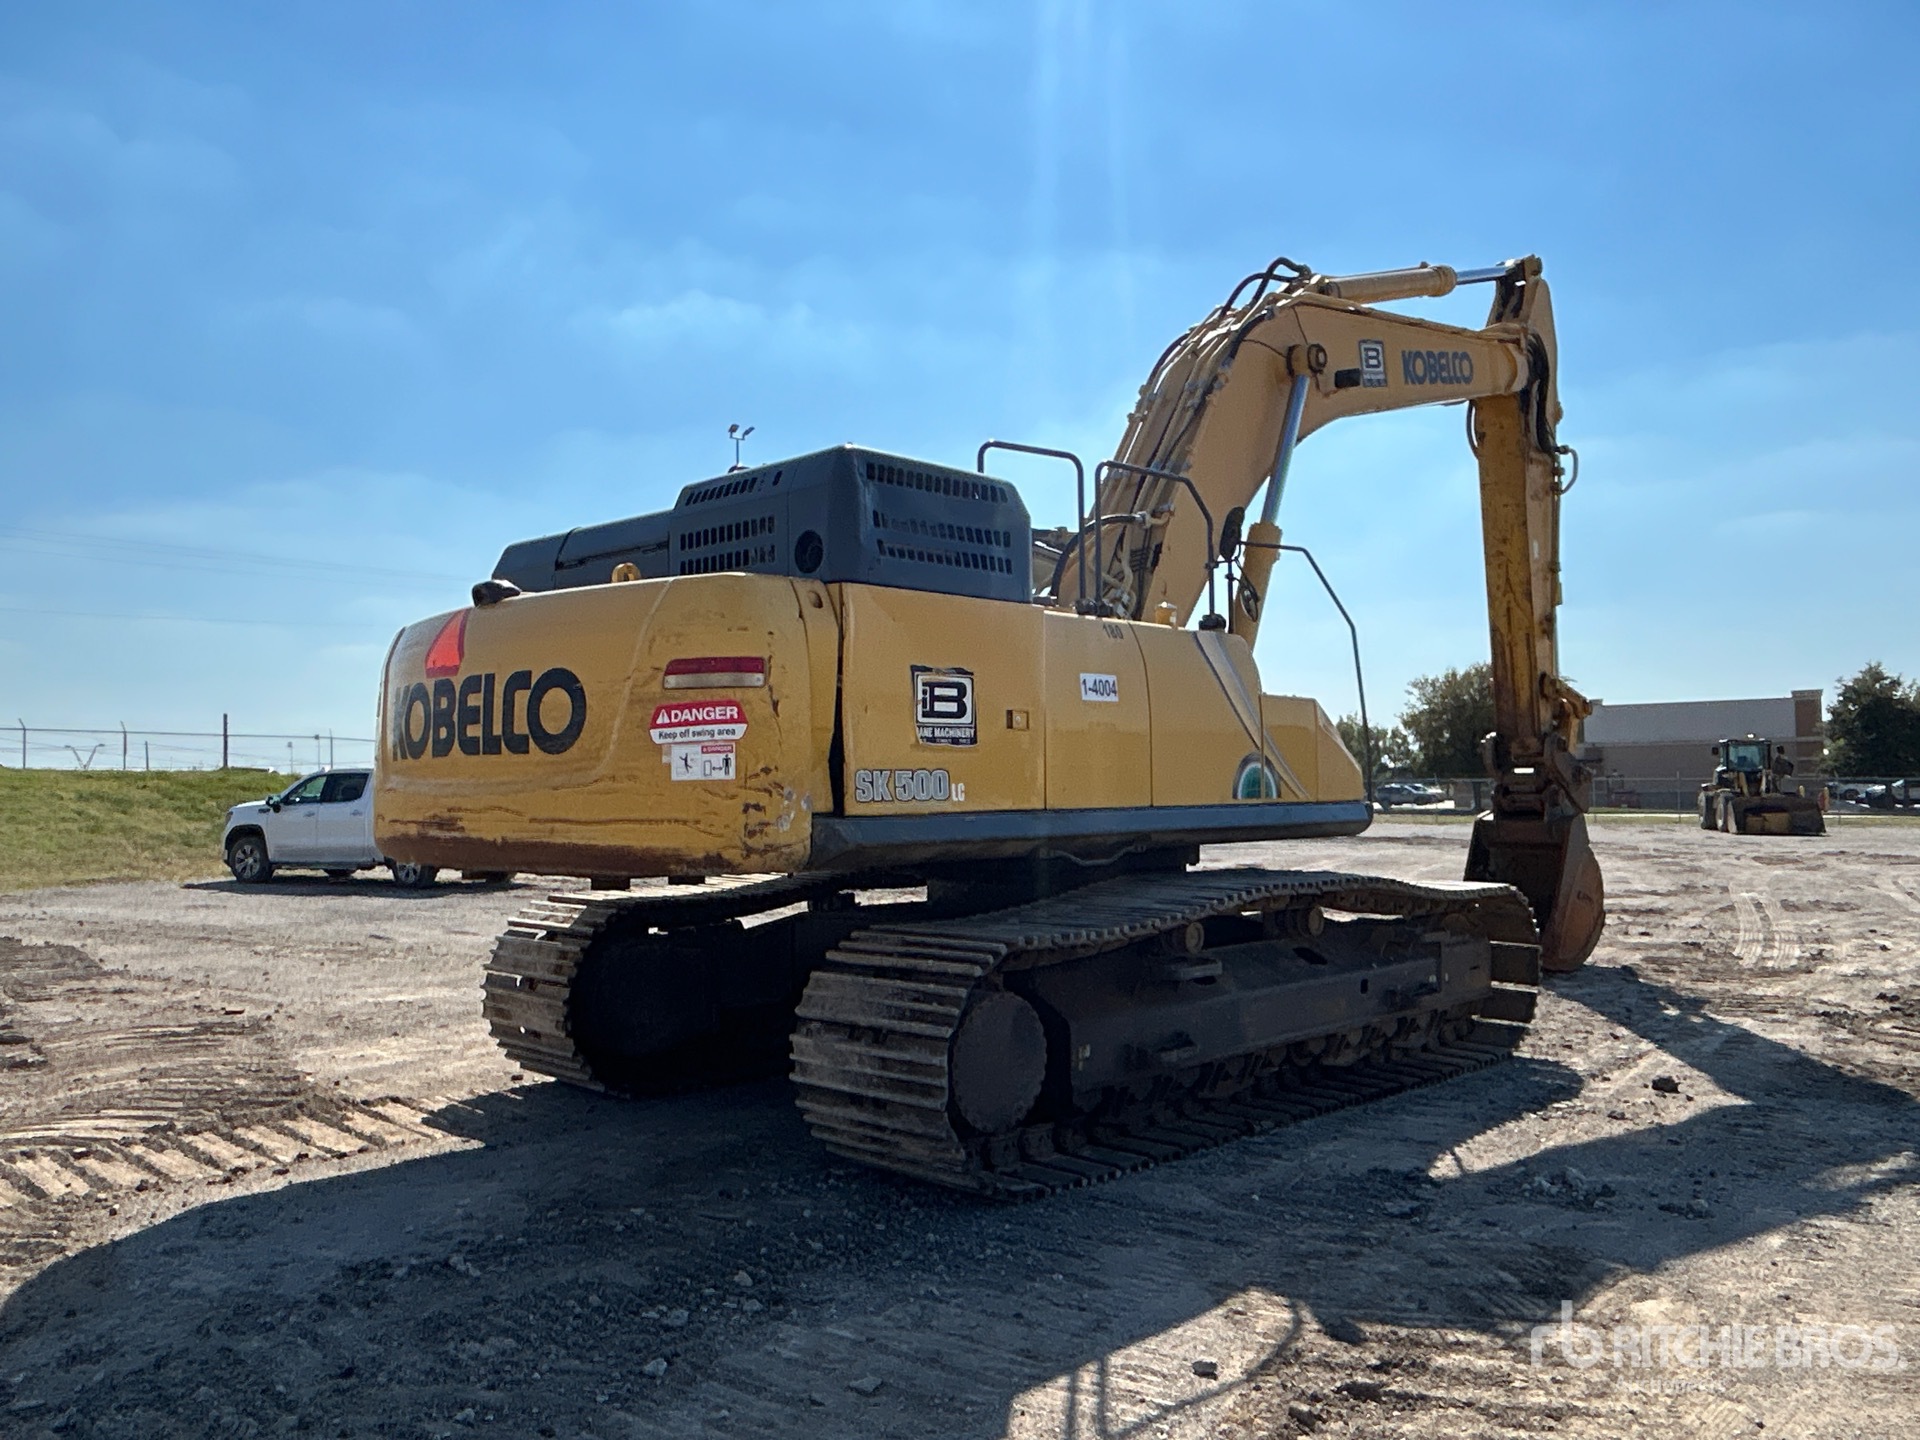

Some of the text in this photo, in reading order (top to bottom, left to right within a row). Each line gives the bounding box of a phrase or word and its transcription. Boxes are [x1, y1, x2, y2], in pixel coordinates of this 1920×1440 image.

[1401, 350, 1474, 385] KOBELCO
[1082, 678, 1118, 697] 1-4004
[392, 667, 587, 762] KOBELCO
[670, 706, 739, 723] DANGER
[658, 728, 736, 740] Keep off swing area
[855, 767, 966, 803] SK 500 LC
